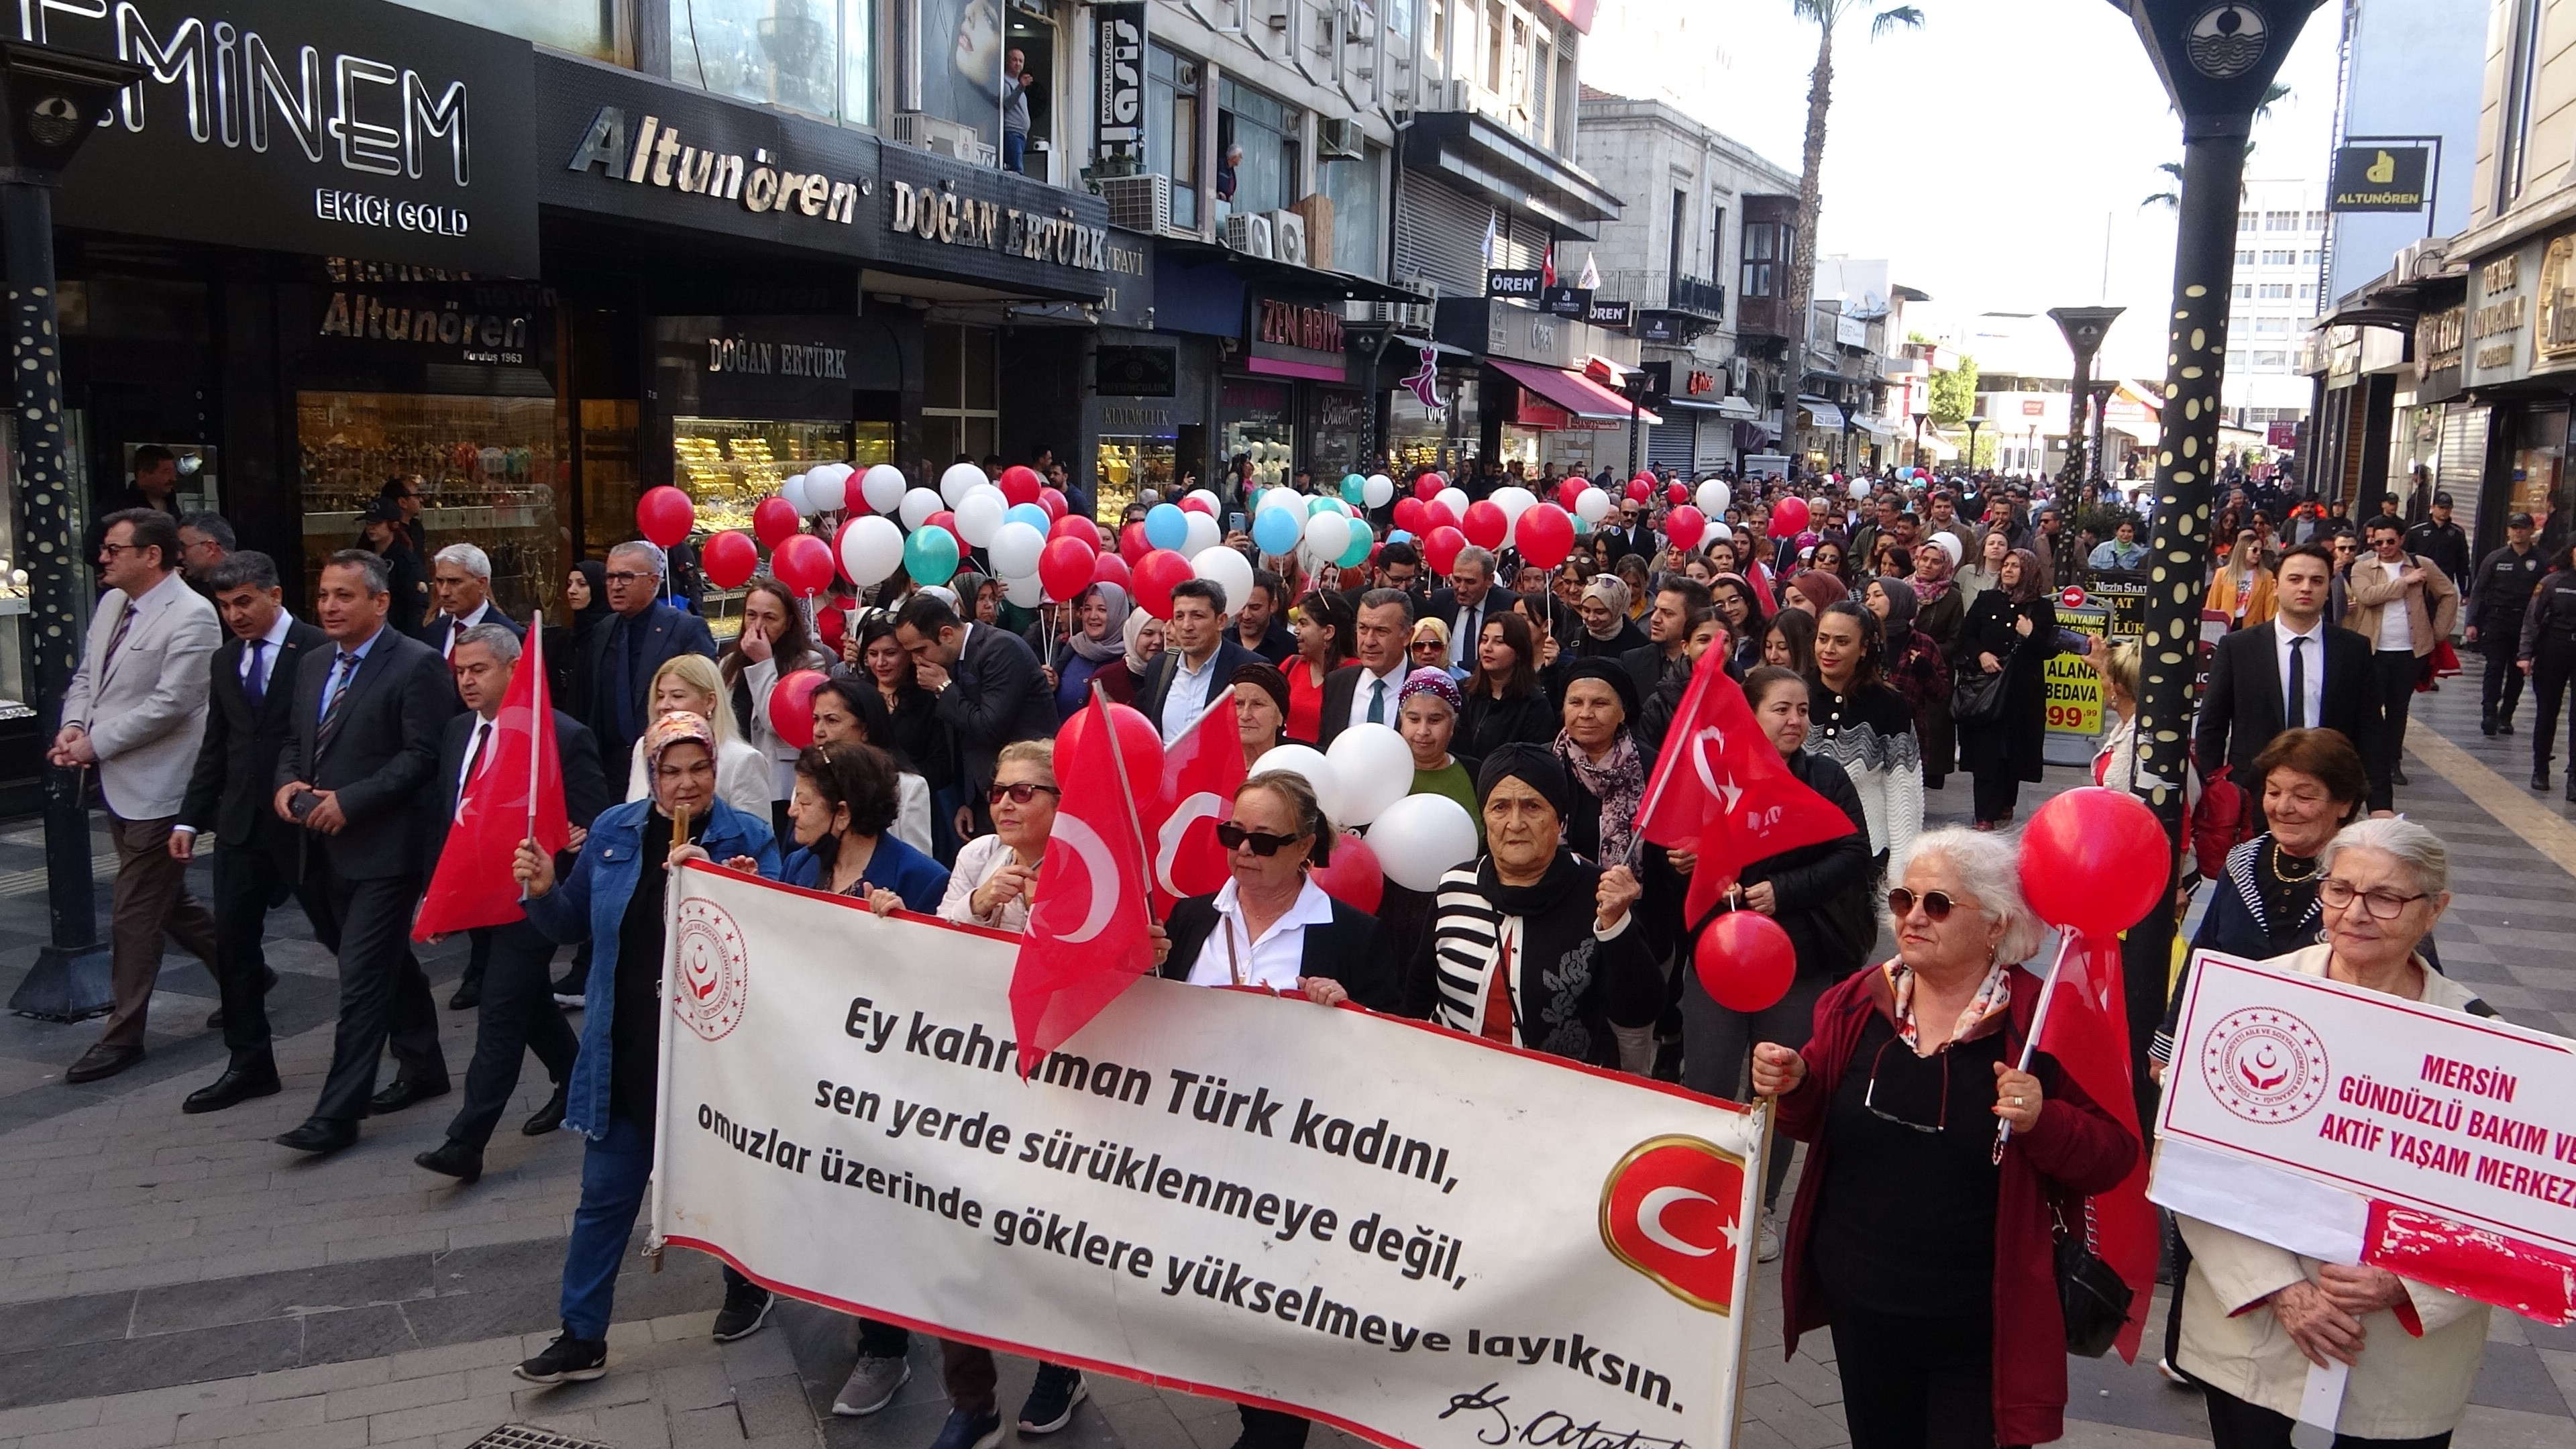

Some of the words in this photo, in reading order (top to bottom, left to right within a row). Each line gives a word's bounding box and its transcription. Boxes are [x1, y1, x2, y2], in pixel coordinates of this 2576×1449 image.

[568, 106, 858, 224] Altunören
[315, 188, 391, 228] EKİCİ
[396, 200, 469, 237] GOLD
[2337, 192, 2419, 204] ALTUNÖREN
[891, 179, 998, 250] DOĞAN
[1004, 207, 1108, 272] ERTÜRK
[1492, 274, 1534, 292] ÖREN
[319, 292, 526, 349] Altunören
[1263, 299, 1298, 346] ZEN
[463, 350, 498, 364] Kuruluş
[500, 352, 523, 364] 1963
[708, 331, 771, 376] DOĞAN
[781, 339, 847, 380] ERTÜRK
[1104, 407, 1169, 426] KUYUMCULUK
[2046, 682, 2098, 702] BEDAVA
[2047, 661, 2097, 680] ALANA
[2245, 1028, 2261, 1037] AİLE
[2271, 1030, 2295, 1049] SOSYAL
[846, 996, 899, 1053] Ey
[1167, 1068, 1283, 1137] Türk
[1289, 1097, 1460, 1195] kadını,
[2420, 1054, 2518, 1104] MERSİN
[2338, 1075, 2463, 1132] GÜNDÜZLÜ
[2467, 1109, 2548, 1156] BAKIM
[815, 1077, 881, 1122] sen
[887, 1097, 1012, 1155] yerde
[1018, 1128, 1338, 1243] sürüklenmeye
[1349, 1212, 1468, 1291] değil,
[2318, 1113, 2383, 1152] AKTİF
[2390, 1130, 2469, 1179] YAŞAM
[2475, 1155, 2576, 1210] MERKEZ
[698, 1102, 812, 1175] omuzlar
[820, 1146, 983, 1229] üzerinde
[994, 1208, 1154, 1279] göklere
[1161, 1254, 1451, 1354] yükselmeye
[1467, 1328, 1684, 1415] layıksın.
